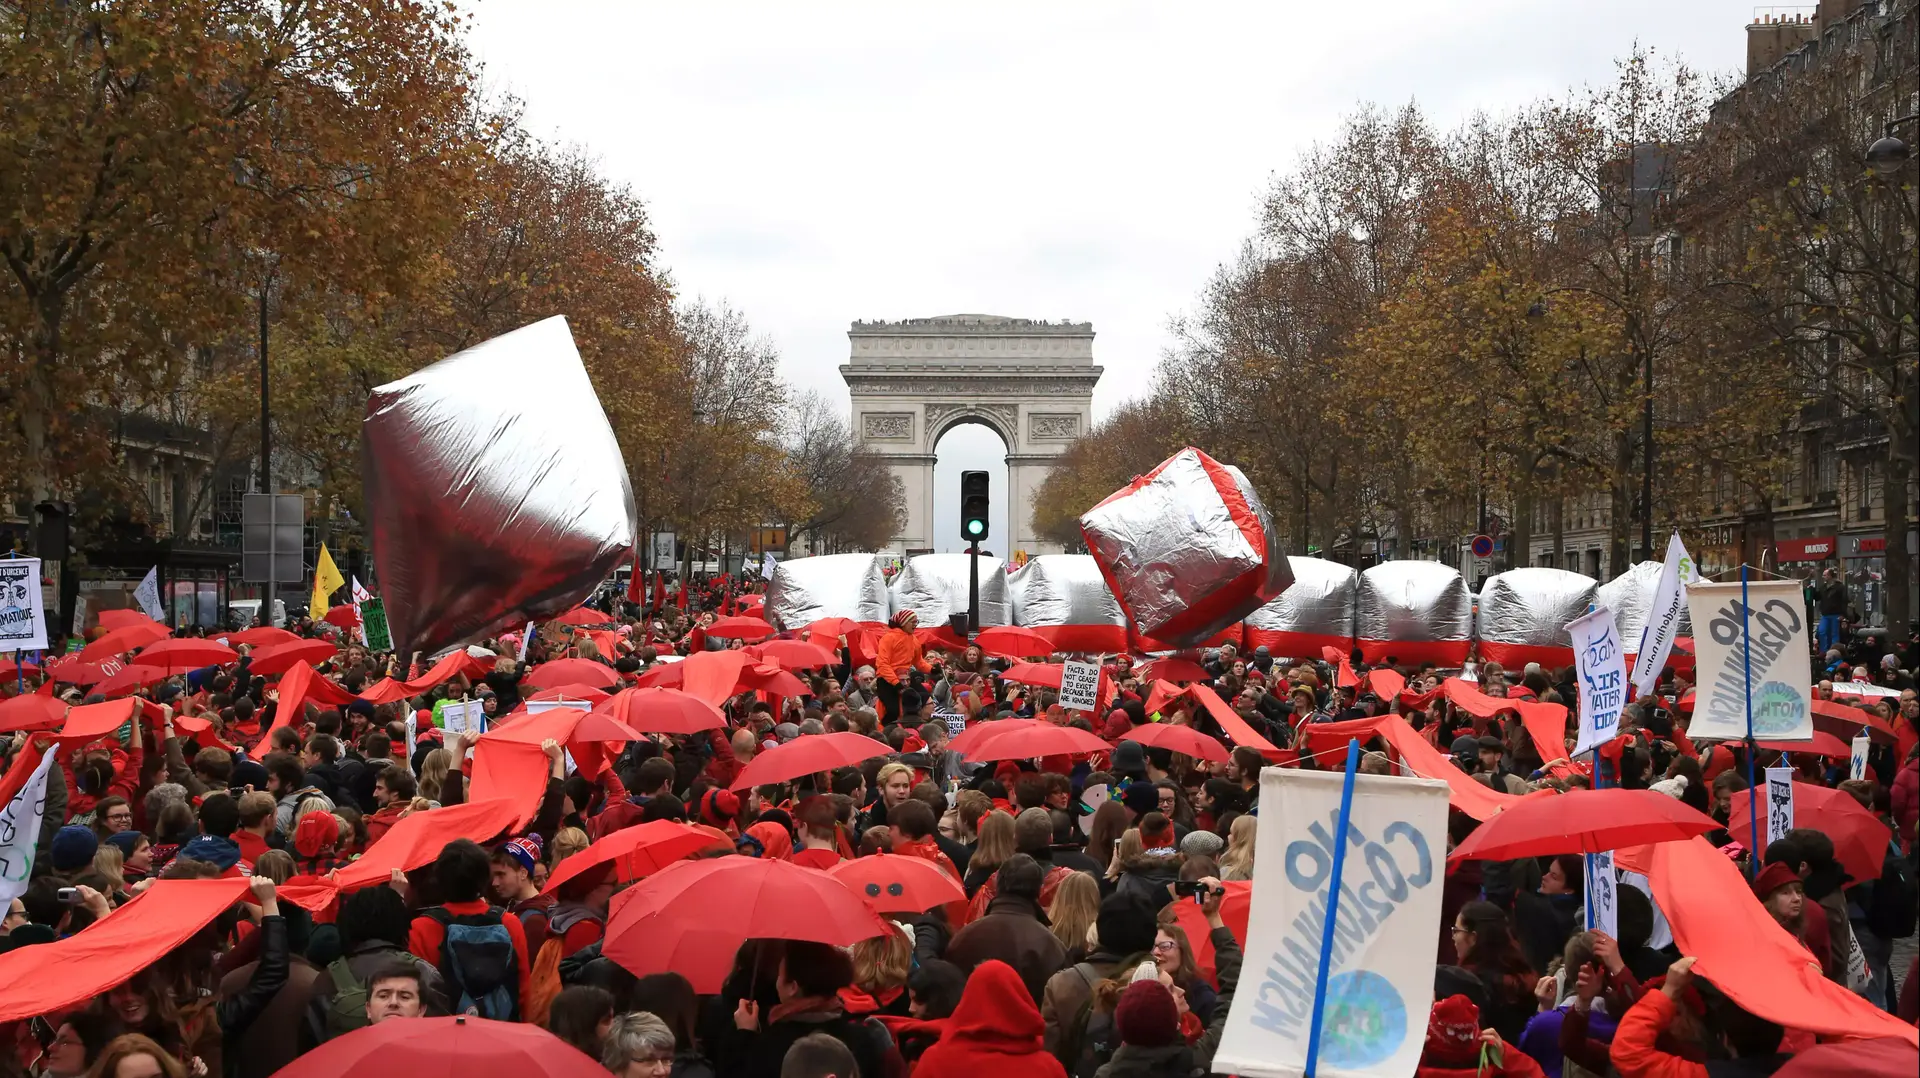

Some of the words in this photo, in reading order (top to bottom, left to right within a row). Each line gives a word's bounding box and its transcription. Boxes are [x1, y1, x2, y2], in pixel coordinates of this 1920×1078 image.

[1067, 665, 1085, 675] FACTS
[1078, 675, 1096, 684] CEASE
[1063, 687, 1084, 696] BECAUSE
[1085, 690, 1096, 698] THEY
[1072, 697, 1095, 706] IGNORED
[1592, 710, 1618, 731] OOD
